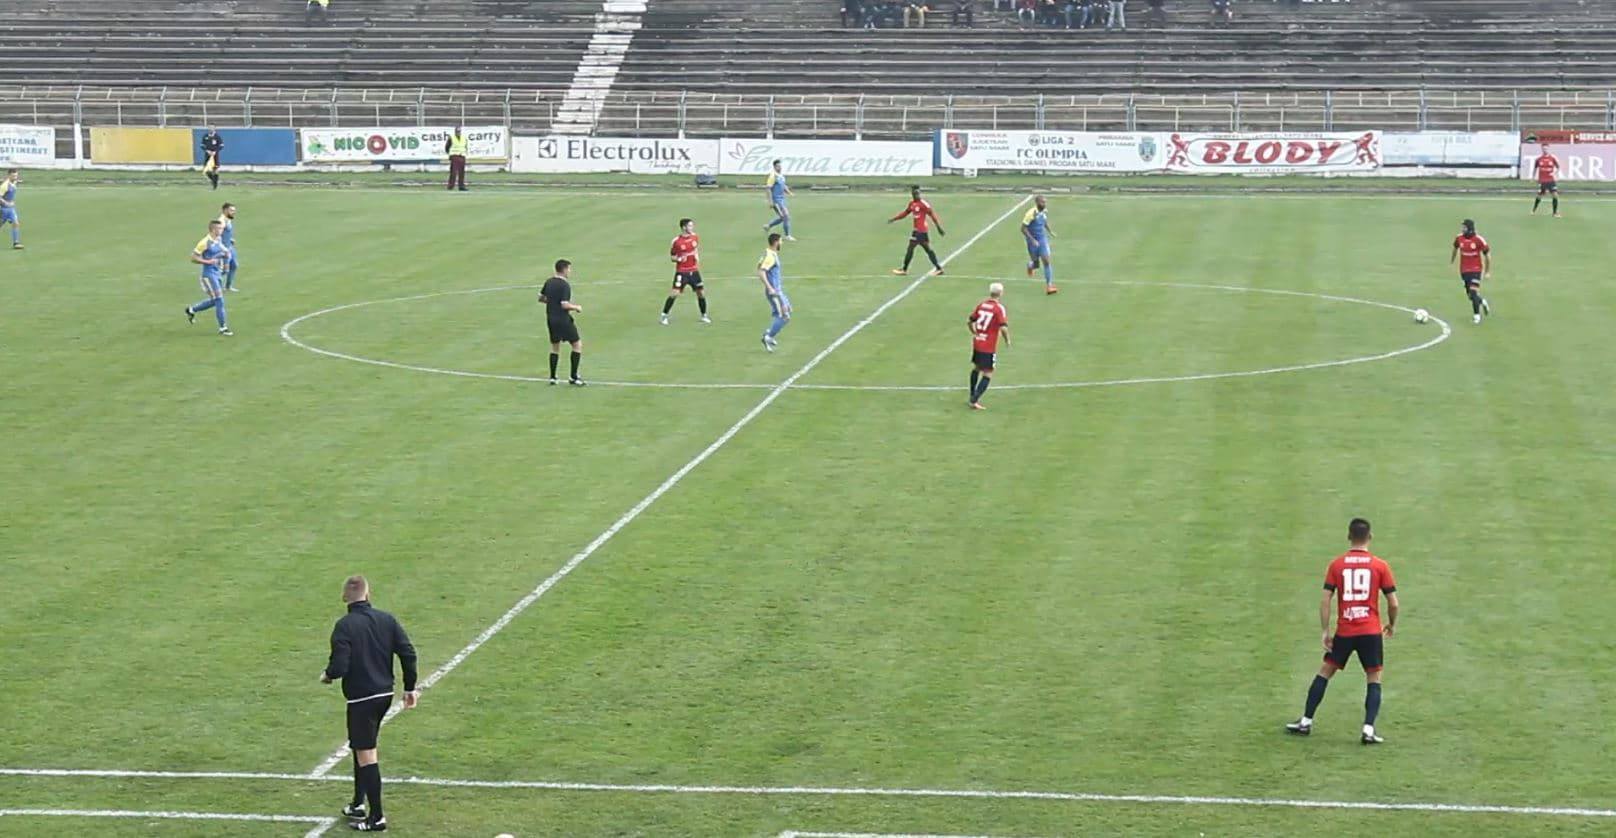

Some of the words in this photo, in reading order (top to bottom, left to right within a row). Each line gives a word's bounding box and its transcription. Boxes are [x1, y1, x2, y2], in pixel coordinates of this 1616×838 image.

[421, 131, 450, 142] cash
[468, 132, 501, 143] carry
[1042, 136, 1064, 145] LIGA
[1067, 137, 1075, 145] 2
[567, 139, 691, 160] Electrolux
[1035, 148, 1088, 159] OLIMPIA
[1203, 141, 1341, 164] BLODY
[838, 155, 924, 173] center
[976, 309, 994, 332] 27
[1342, 568, 1371, 601] 19
